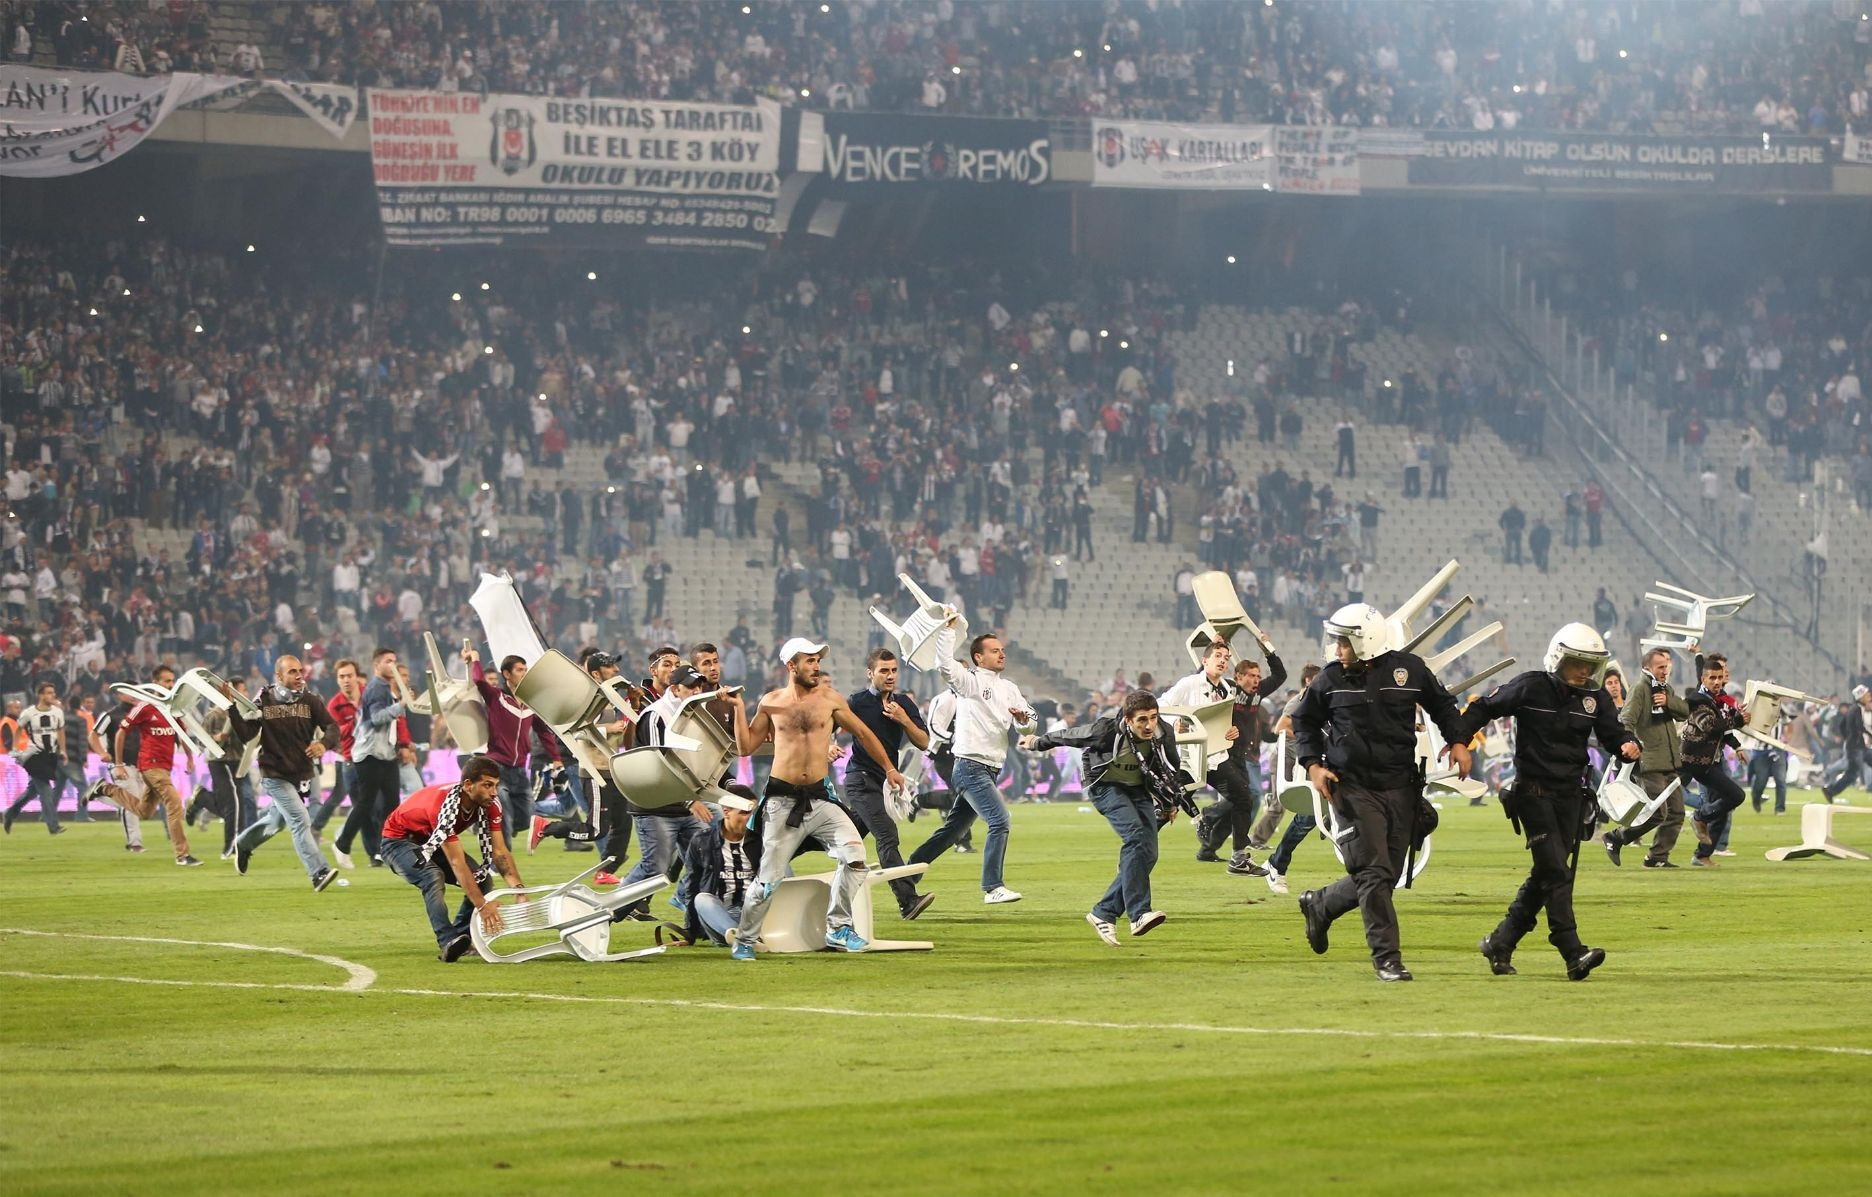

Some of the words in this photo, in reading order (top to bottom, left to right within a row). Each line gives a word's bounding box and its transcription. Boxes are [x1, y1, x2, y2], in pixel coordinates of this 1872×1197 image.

[547, 101, 655, 132] BEŞİKTAŞ
[563, 130, 599, 158] İLE
[606, 137, 633, 159] EL
[640, 139, 680, 161] ELE
[687, 140, 703, 162] 3
[711, 138, 760, 163] KÖY
[825, 134, 921, 182] VENCE
[957, 139, 1049, 185] REMOS
[1504, 137, 1560, 160] KİTAP
[1566, 143, 1631, 162] OLSUN
[1638, 145, 1715, 166] OKULDA
[1722, 147, 1824, 164] DERSLERE
[541, 163, 627, 185] OKULU
[421, 207, 451, 223] NO:
[506, 207, 548, 223] 0001
[555, 207, 598, 224] 0006
[601, 209, 647, 225] 6965
[651, 210, 697, 226] 3484
[701, 212, 748, 229] 2850
[150, 727, 176, 736] TOYO
